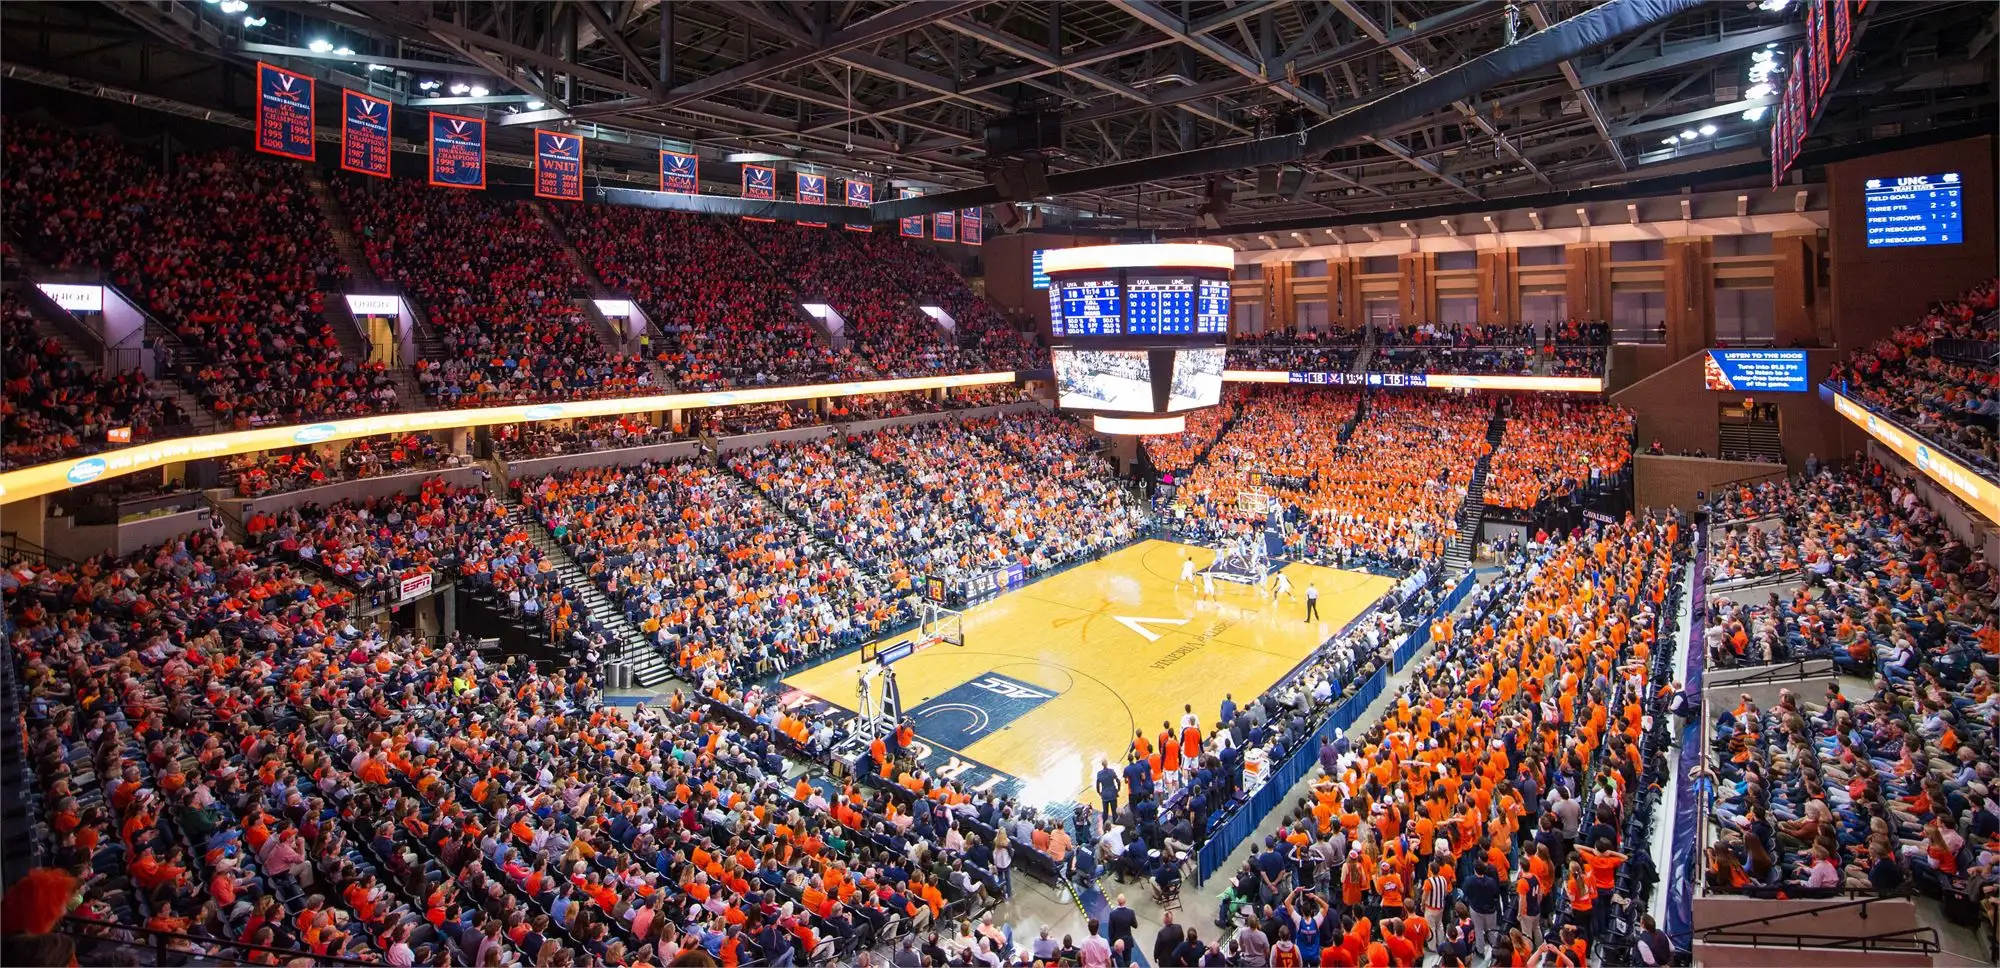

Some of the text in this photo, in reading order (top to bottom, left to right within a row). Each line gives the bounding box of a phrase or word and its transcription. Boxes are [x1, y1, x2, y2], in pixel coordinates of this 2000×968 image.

[279, 73, 295, 91] V
[362, 99, 376, 115] V
[265, 112, 308, 127] CHAMPIONS
[451, 119, 467, 133] V
[552, 136, 567, 149] V
[438, 152, 479, 162] CHAMPIONS
[673, 155, 686, 168] V
[543, 159, 576, 172] WNIT
[668, 176, 691, 184] NCAA
[754, 169, 765, 180] V
[806, 176, 817, 187] V
[1897, 175, 1928, 186] UNC
[855, 184, 864, 194] V
[1889, 193, 1916, 201] GOALS
[1889, 214, 1922, 222] THROWS
[1885, 225, 1927, 233] REBOUNDS
[1312, 373, 1323, 382] 18
[1346, 373, 1364, 381] 11:14
[1388, 375, 1400, 385] 15
[1582, 509, 1613, 524] CAVALIERS
[403, 576, 430, 593] ESPN
[1149, 641, 1206, 669] VIRGINIA
[970, 677, 1054, 698] ACC
